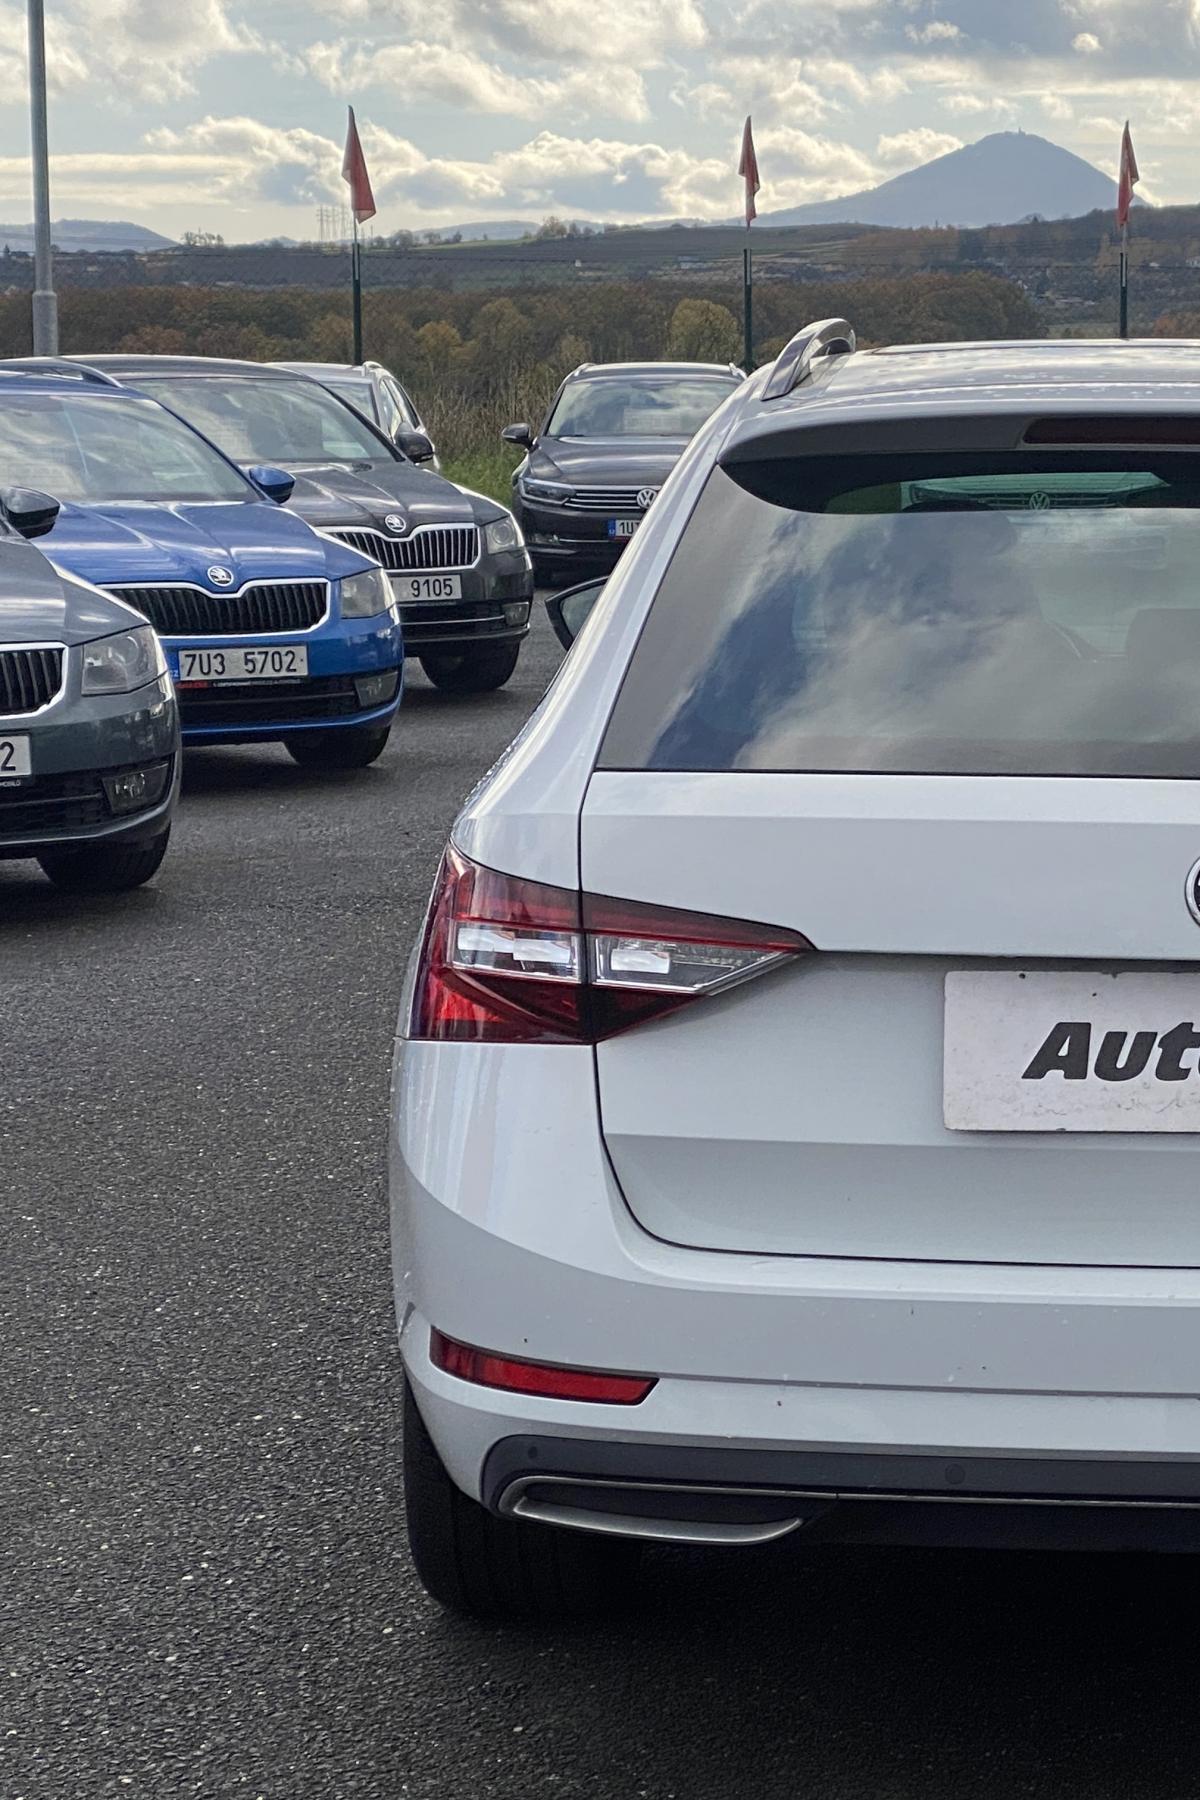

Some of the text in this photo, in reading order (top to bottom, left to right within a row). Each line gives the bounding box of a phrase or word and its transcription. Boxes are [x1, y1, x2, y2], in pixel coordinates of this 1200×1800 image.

[411, 578, 453, 598] 9105
[185, 653, 225, 677] 7U3
[243, 650, 297, 674] 5702
[0, 741, 16, 771] 2
